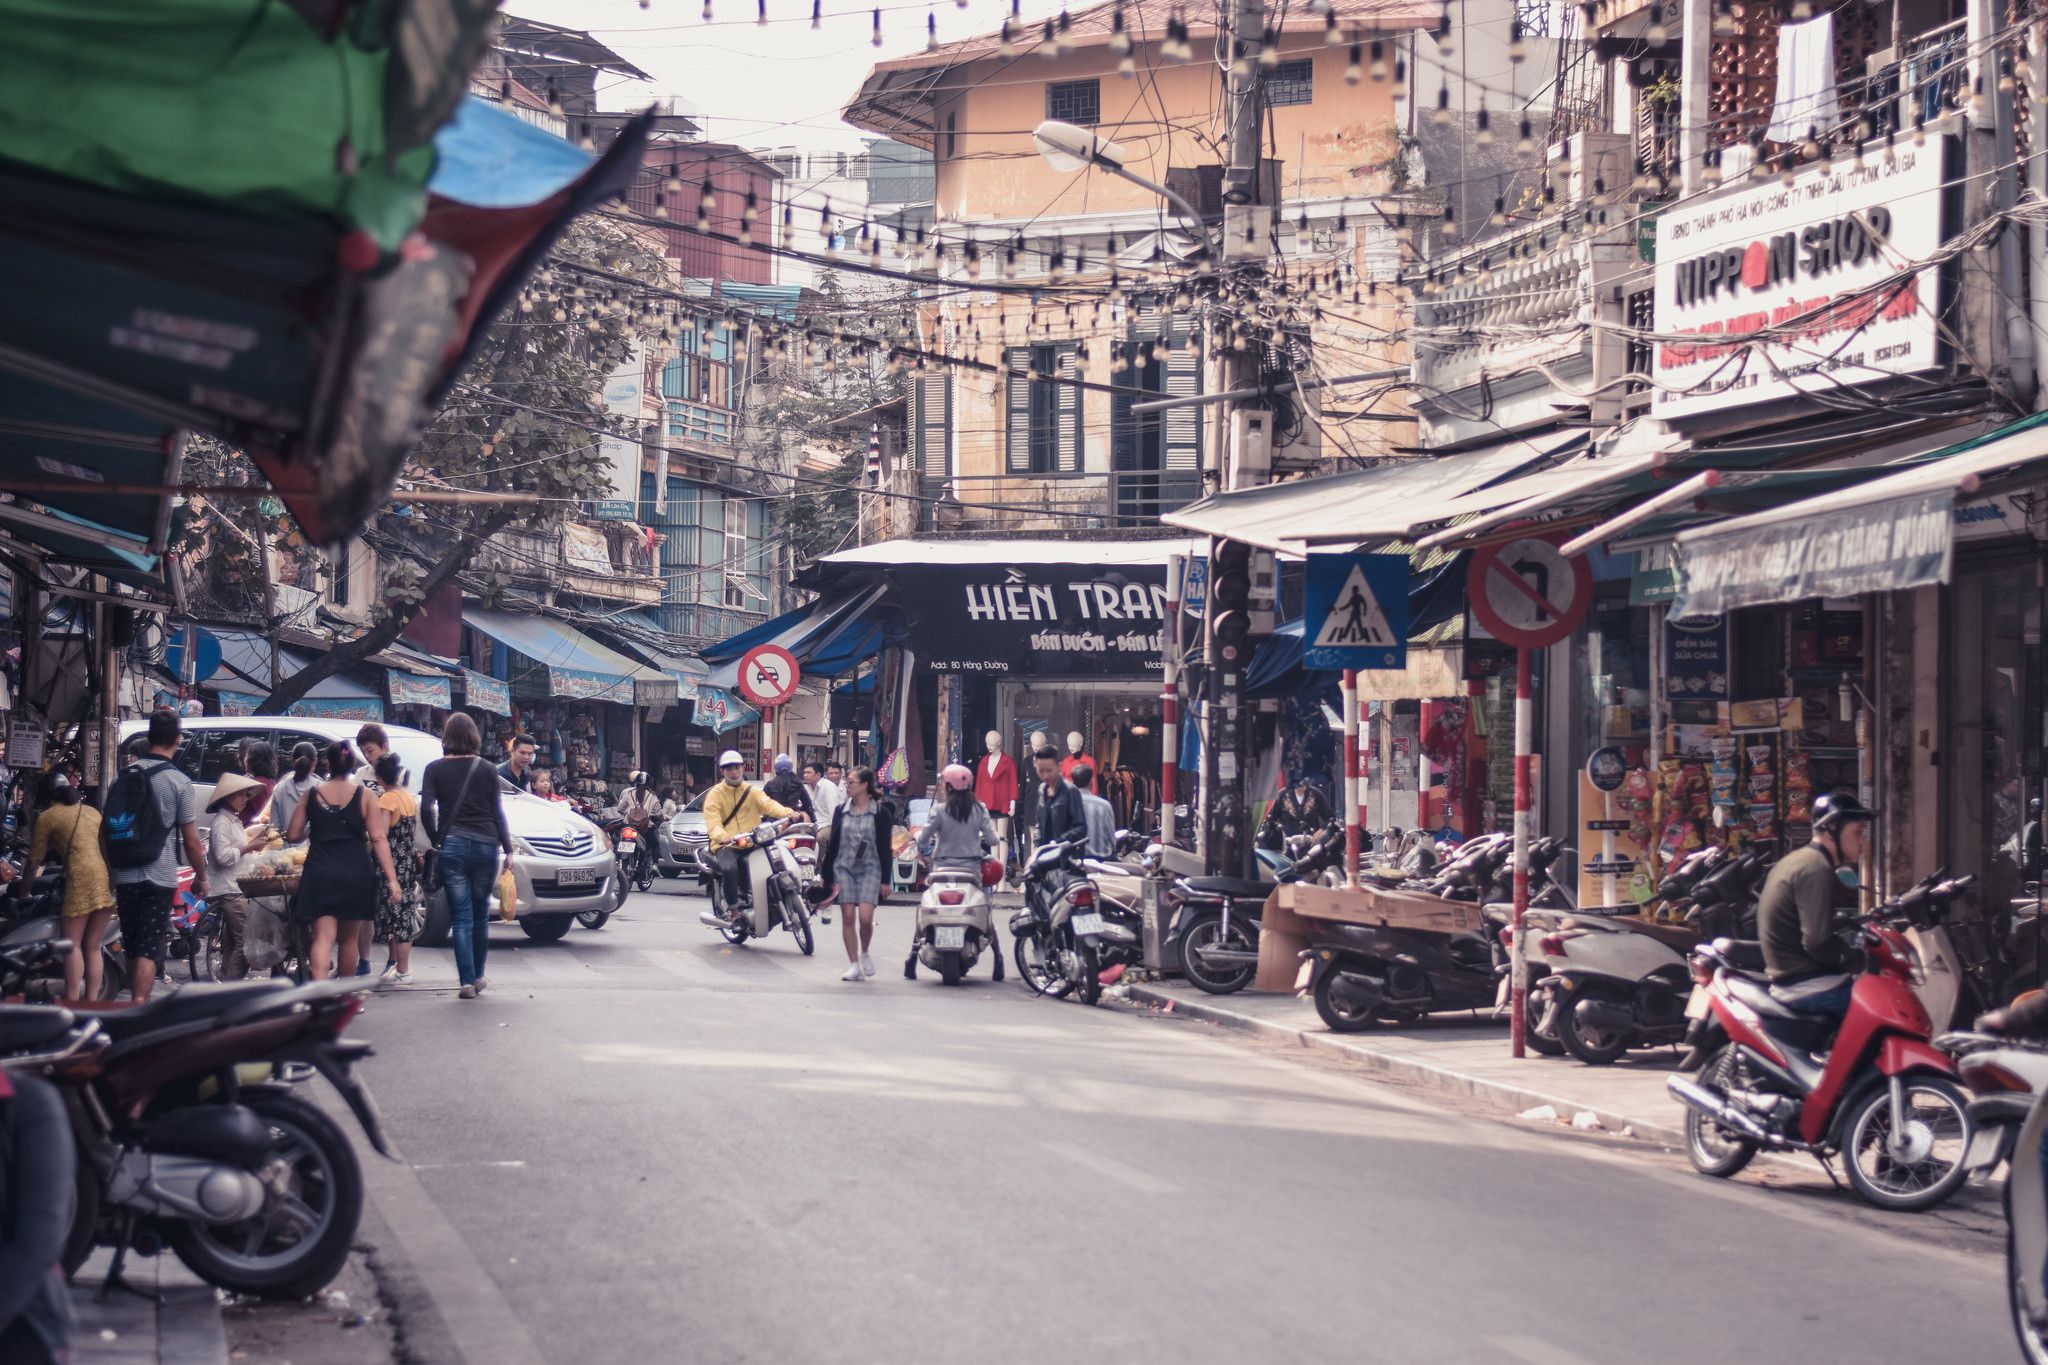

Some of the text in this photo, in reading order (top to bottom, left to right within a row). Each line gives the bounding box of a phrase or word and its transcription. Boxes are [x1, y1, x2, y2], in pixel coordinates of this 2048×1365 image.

[1799, 205, 1892, 278] SHOP
[602, 441, 622, 453] Shop
[965, 567, 1058, 621] HIỀN
[1031, 630, 1061, 651] BÁN
[1062, 631, 1106, 652] BUÔN
[1117, 630, 1147, 651] BÁN
[931, 661, 948, 669] Add:
